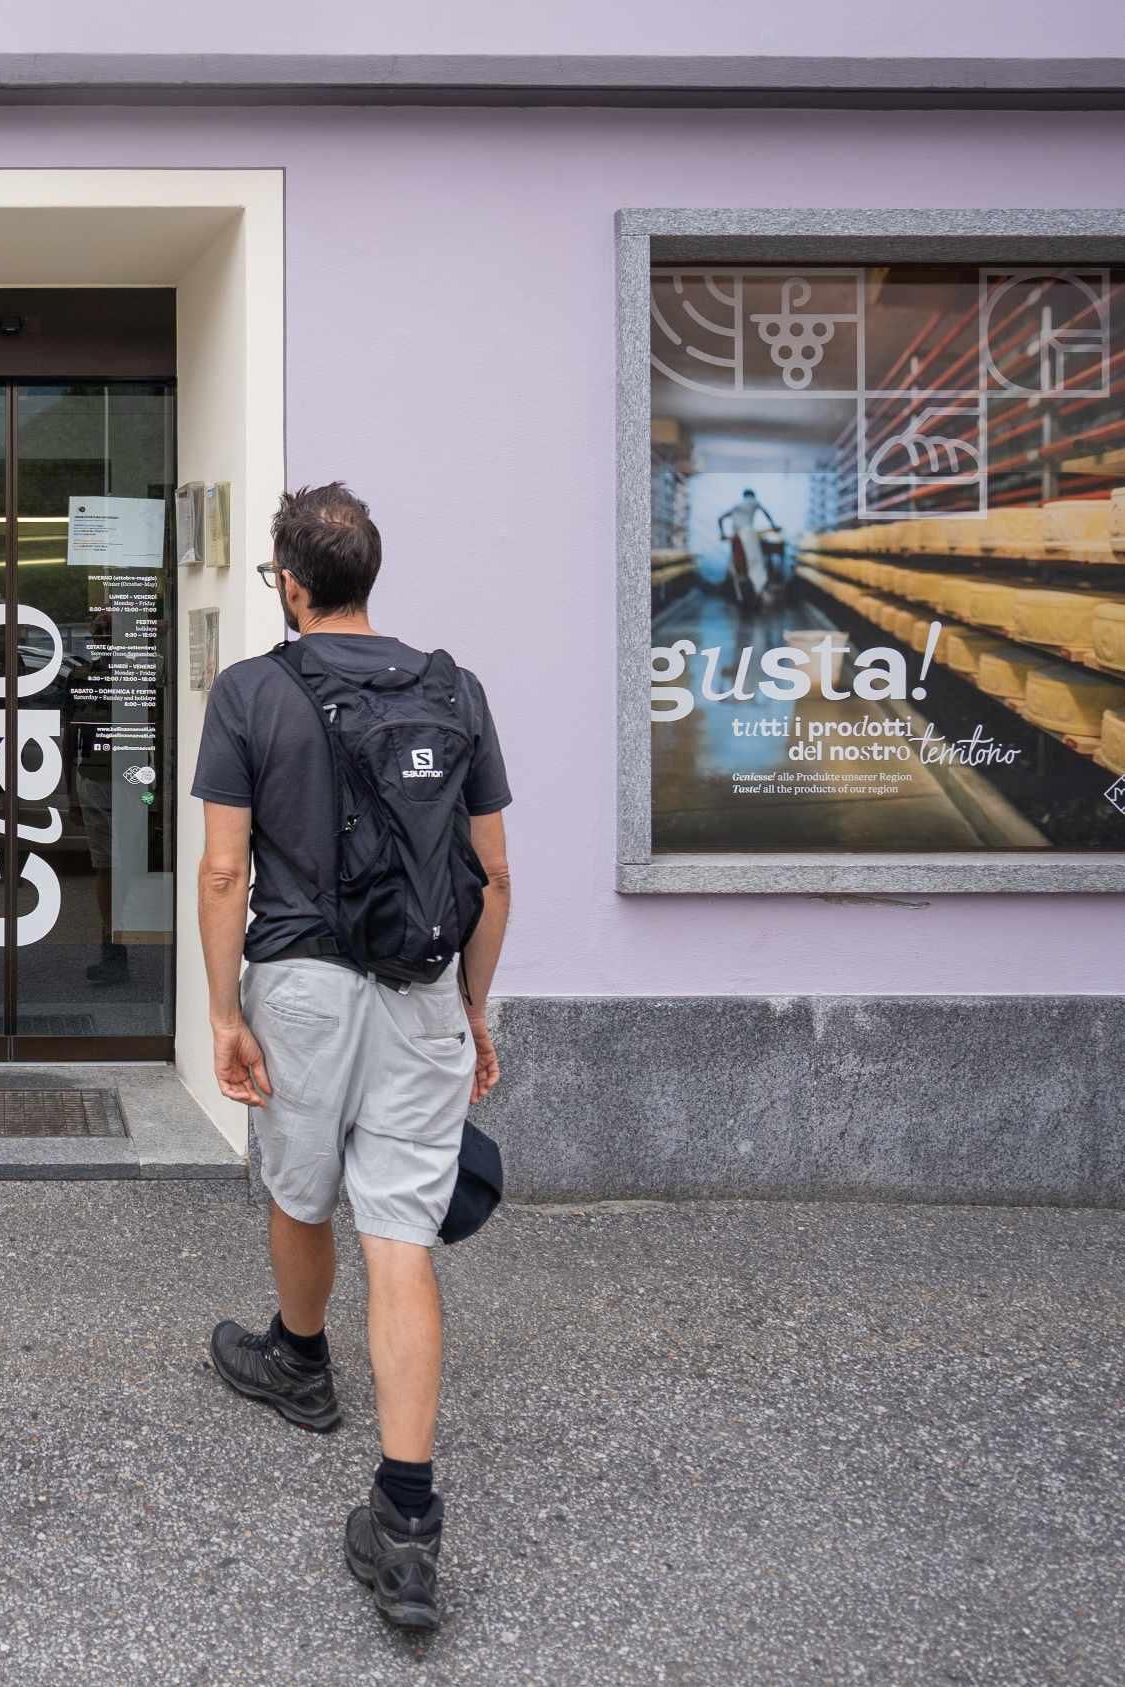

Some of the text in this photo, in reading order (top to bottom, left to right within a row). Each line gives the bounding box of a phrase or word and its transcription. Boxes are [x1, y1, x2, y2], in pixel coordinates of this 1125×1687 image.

[651, 621, 941, 722] gusta!
[732, 716, 914, 741] tutti i prodotti
[789, 723, 1021, 767] del nostro territorio
[732, 772, 776, 781] Geniesse!
[777, 772, 795, 781] alle
[796, 772, 840, 781] Produkte
[879, 772, 913, 783] Region
[732, 783, 762, 793] Taste!
[763, 783, 775, 793] all
[776, 783, 793, 793] the
[794, 783, 836, 795] products
[837, 783, 849, 793] of
[867, 784, 898, 796] region
